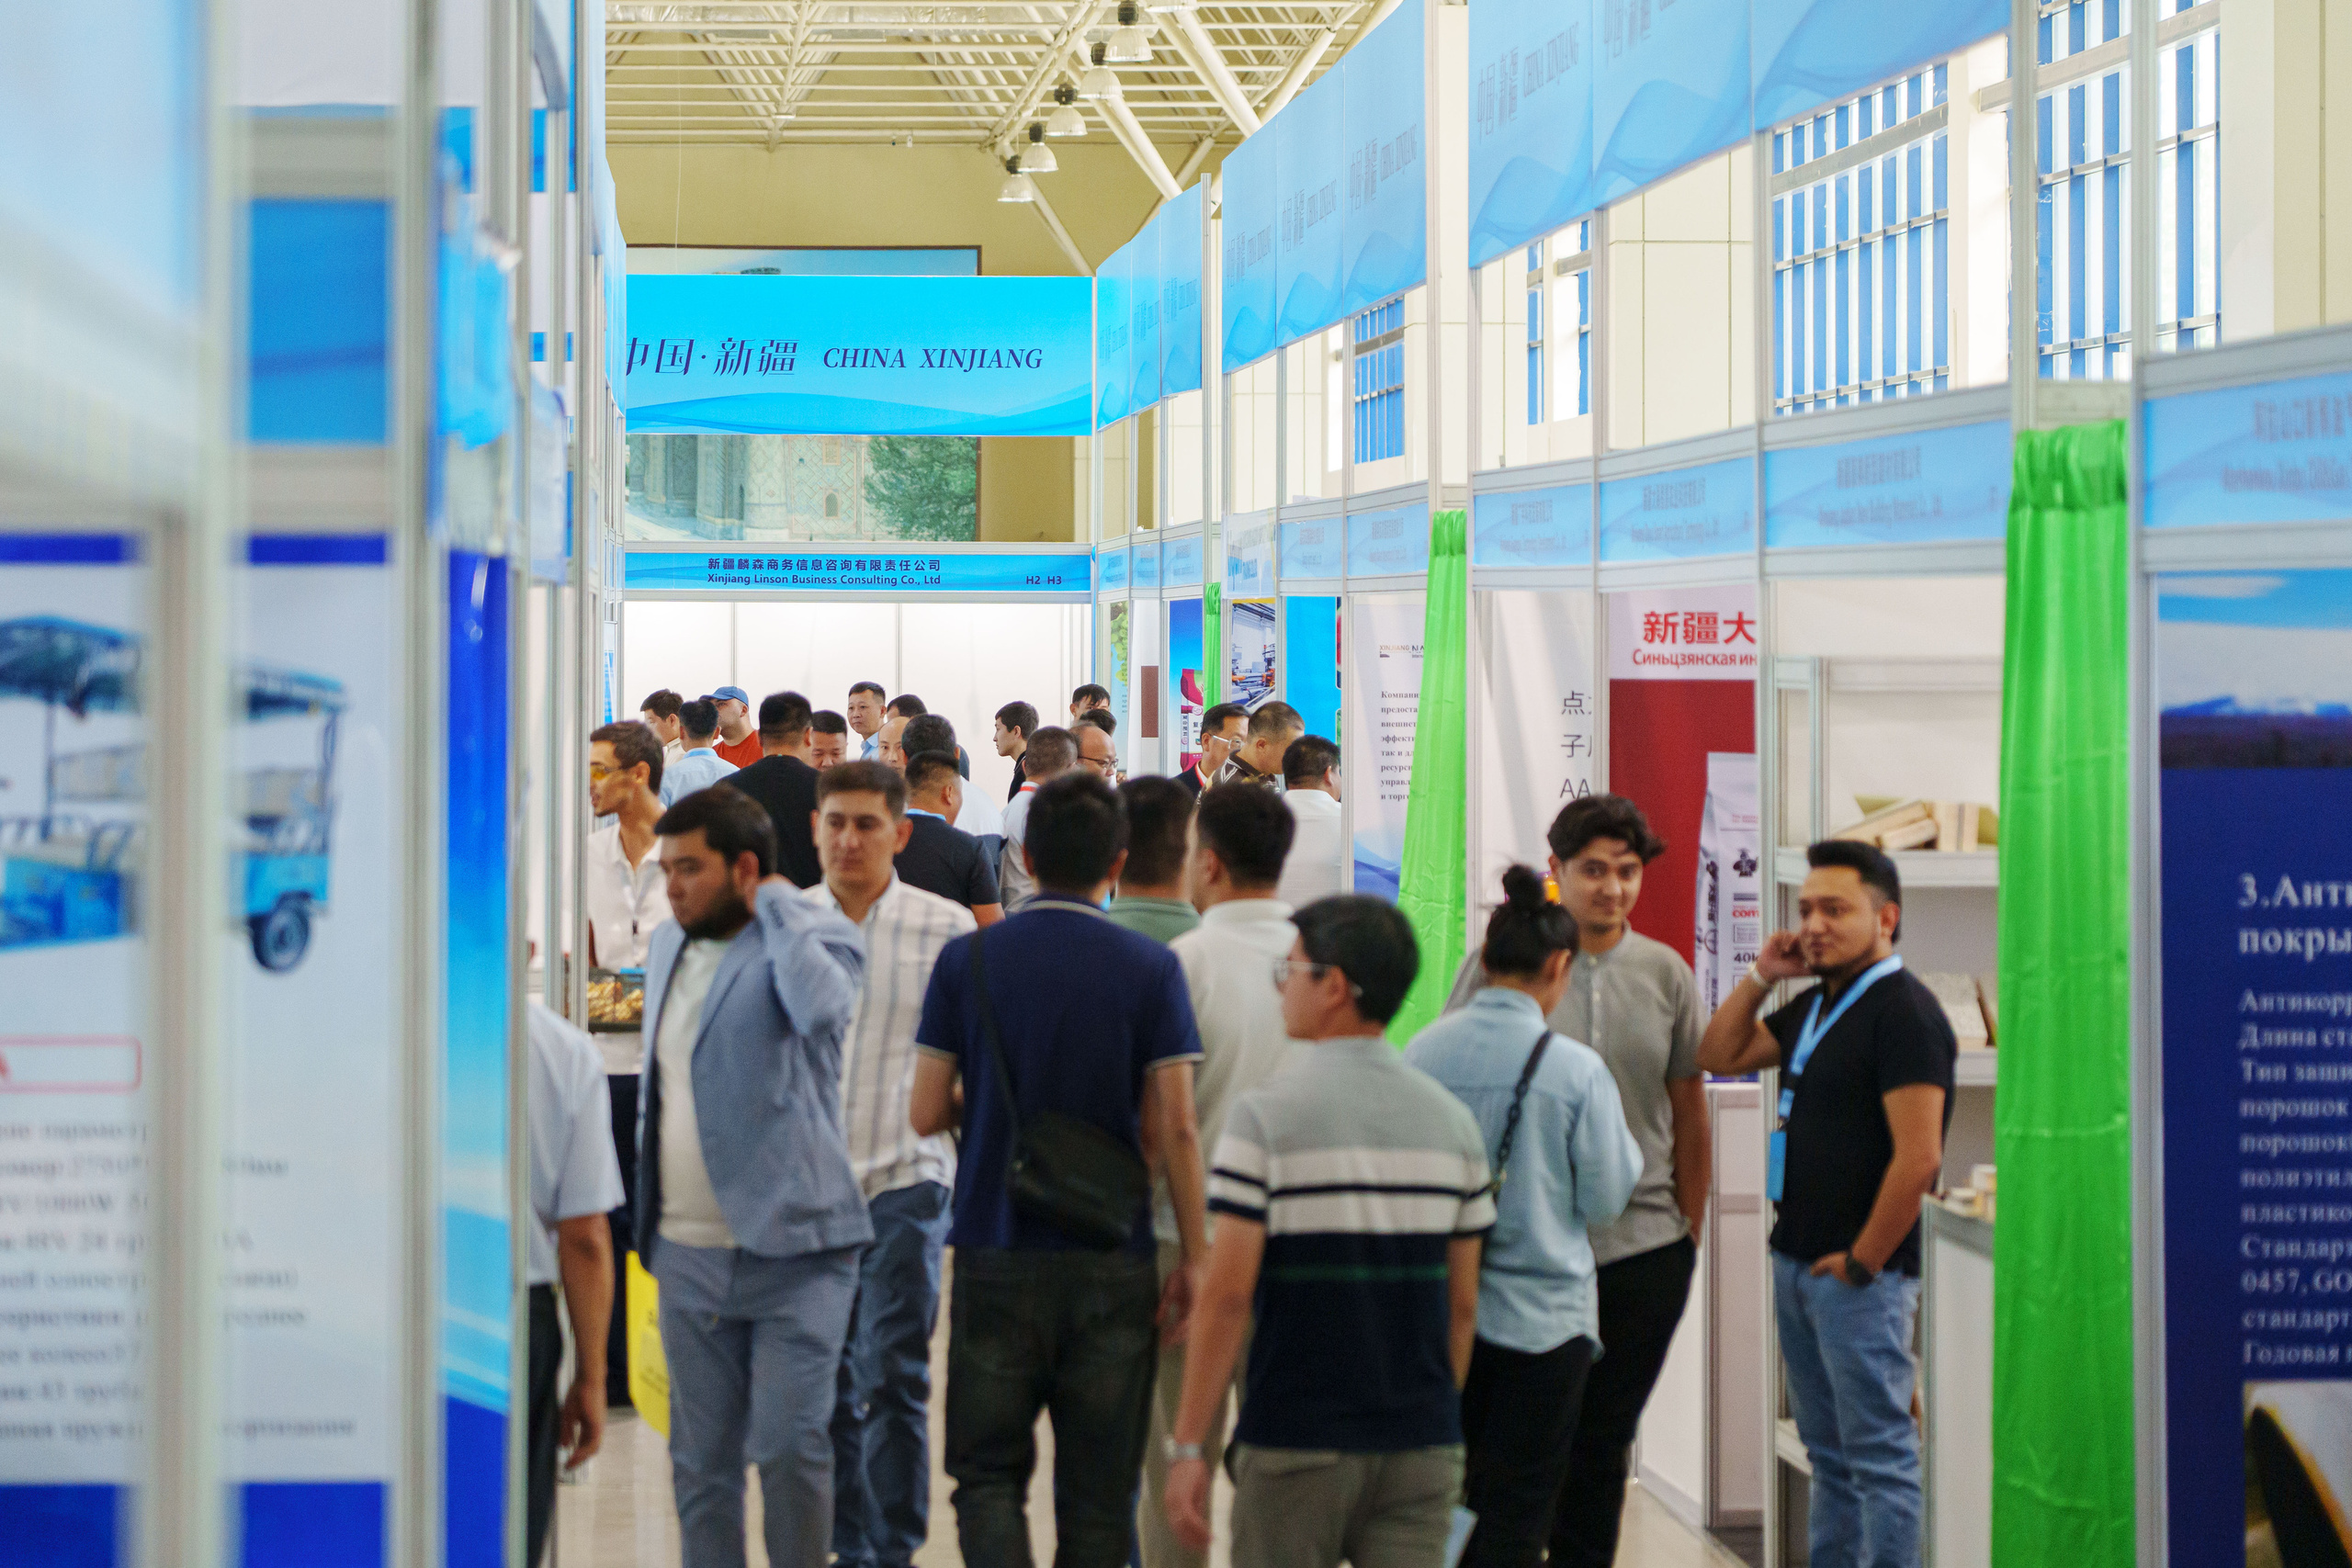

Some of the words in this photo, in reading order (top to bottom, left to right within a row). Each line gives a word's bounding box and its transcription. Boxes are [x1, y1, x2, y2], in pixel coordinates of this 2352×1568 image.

[627, 336, 799, 376] 中国·新疆
[823, 347, 906, 368] CHINA
[920, 348, 1044, 373] XINJIANG
[707, 558, 941, 572] 新疆麟森商务信息咨询有限责任公司
[707, 573, 751, 586] Xinjiang
[754, 574, 789, 584] Linson
[793, 574, 838, 584] Business
[840, 575, 898, 586] Consulting
[900, 575, 921, 586] Co.,
[923, 575, 941, 585] Ltd
[1026, 576, 1041, 585] H2
[1047, 576, 1062, 585] H3
[1643, 610, 1757, 645] 新疆大
[1633, 649, 1736, 669] Синьцзянская
[1381, 691, 1420, 699] Компани
[1561, 690, 1592, 715] 点
[1561, 734, 1592, 759] 子
